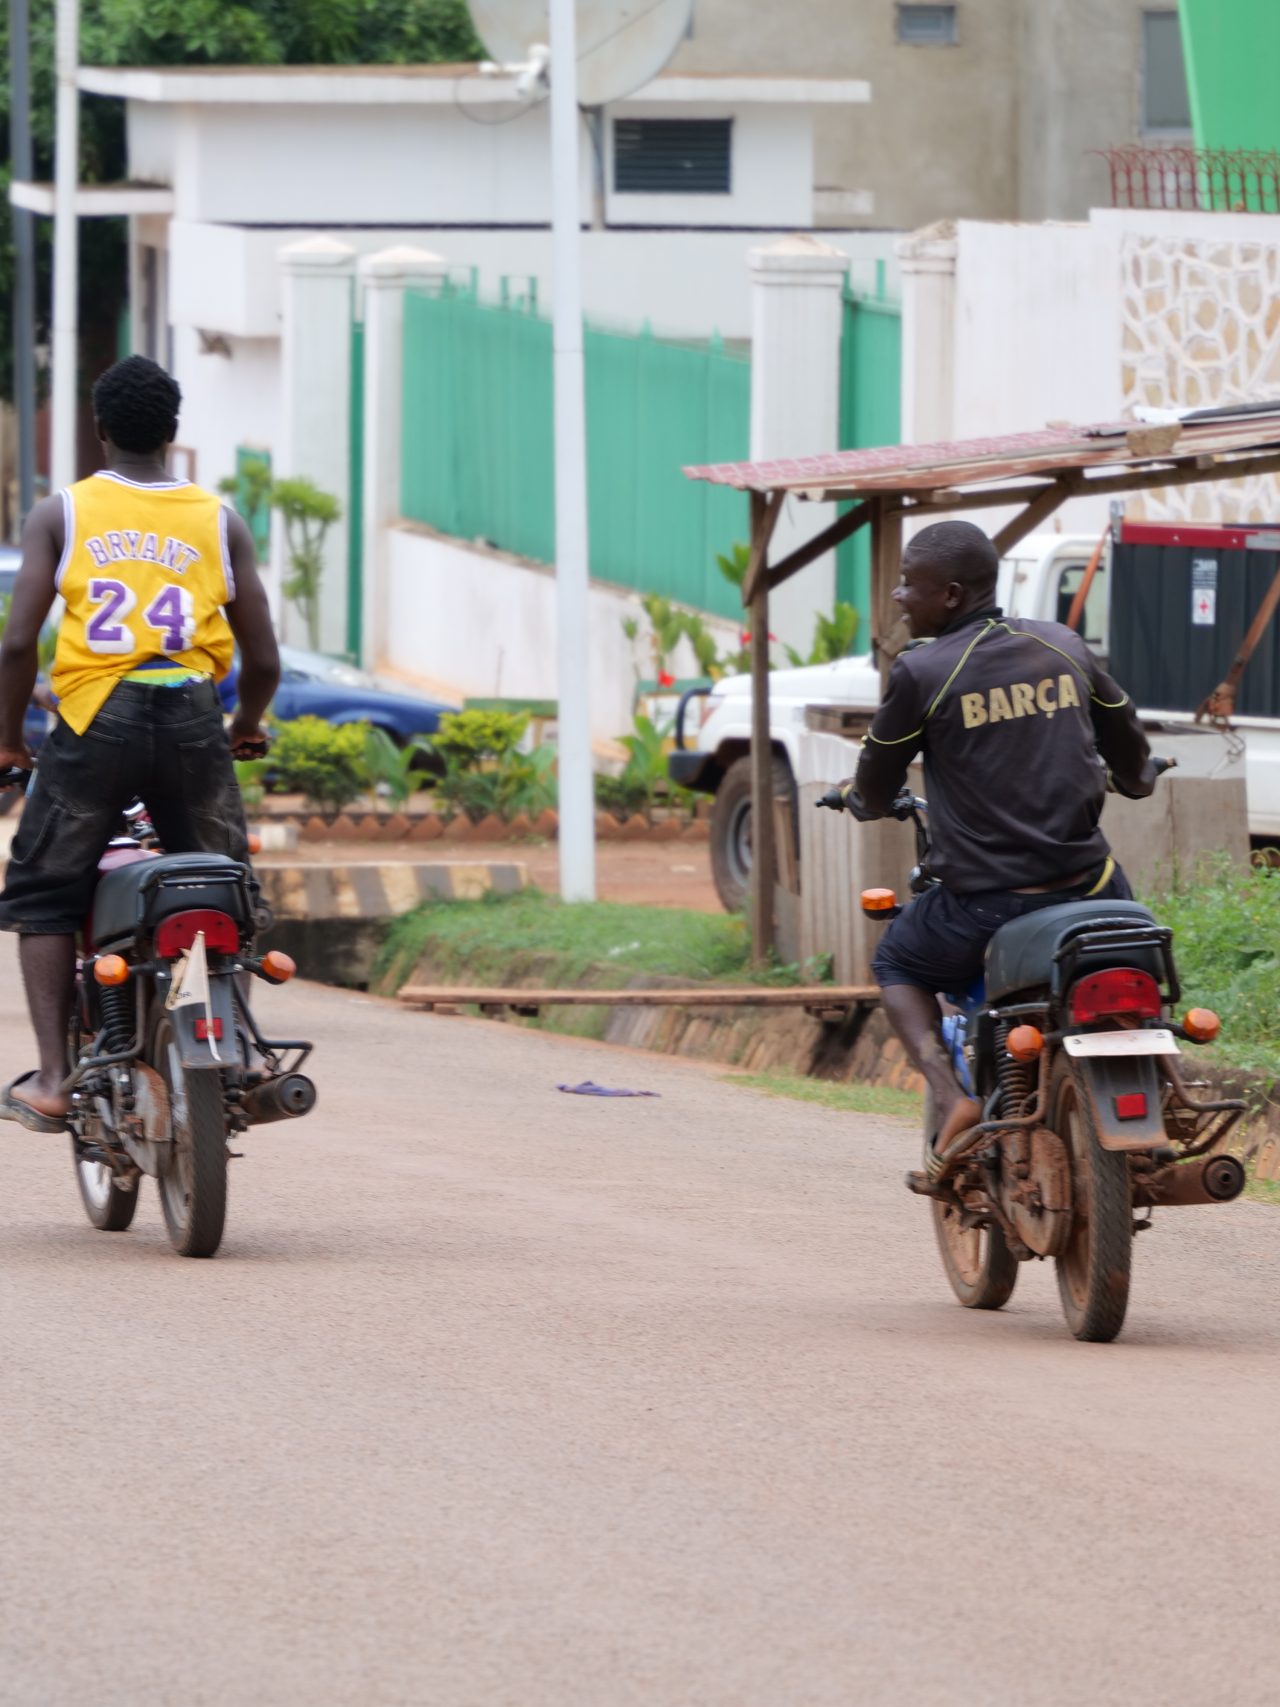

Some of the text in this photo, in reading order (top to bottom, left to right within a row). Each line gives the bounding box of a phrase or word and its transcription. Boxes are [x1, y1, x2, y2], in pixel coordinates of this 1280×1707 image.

[86, 530, 201, 575] BRYANT
[87, 578, 196, 655] 24
[960, 674, 1081, 729] BARÇA
